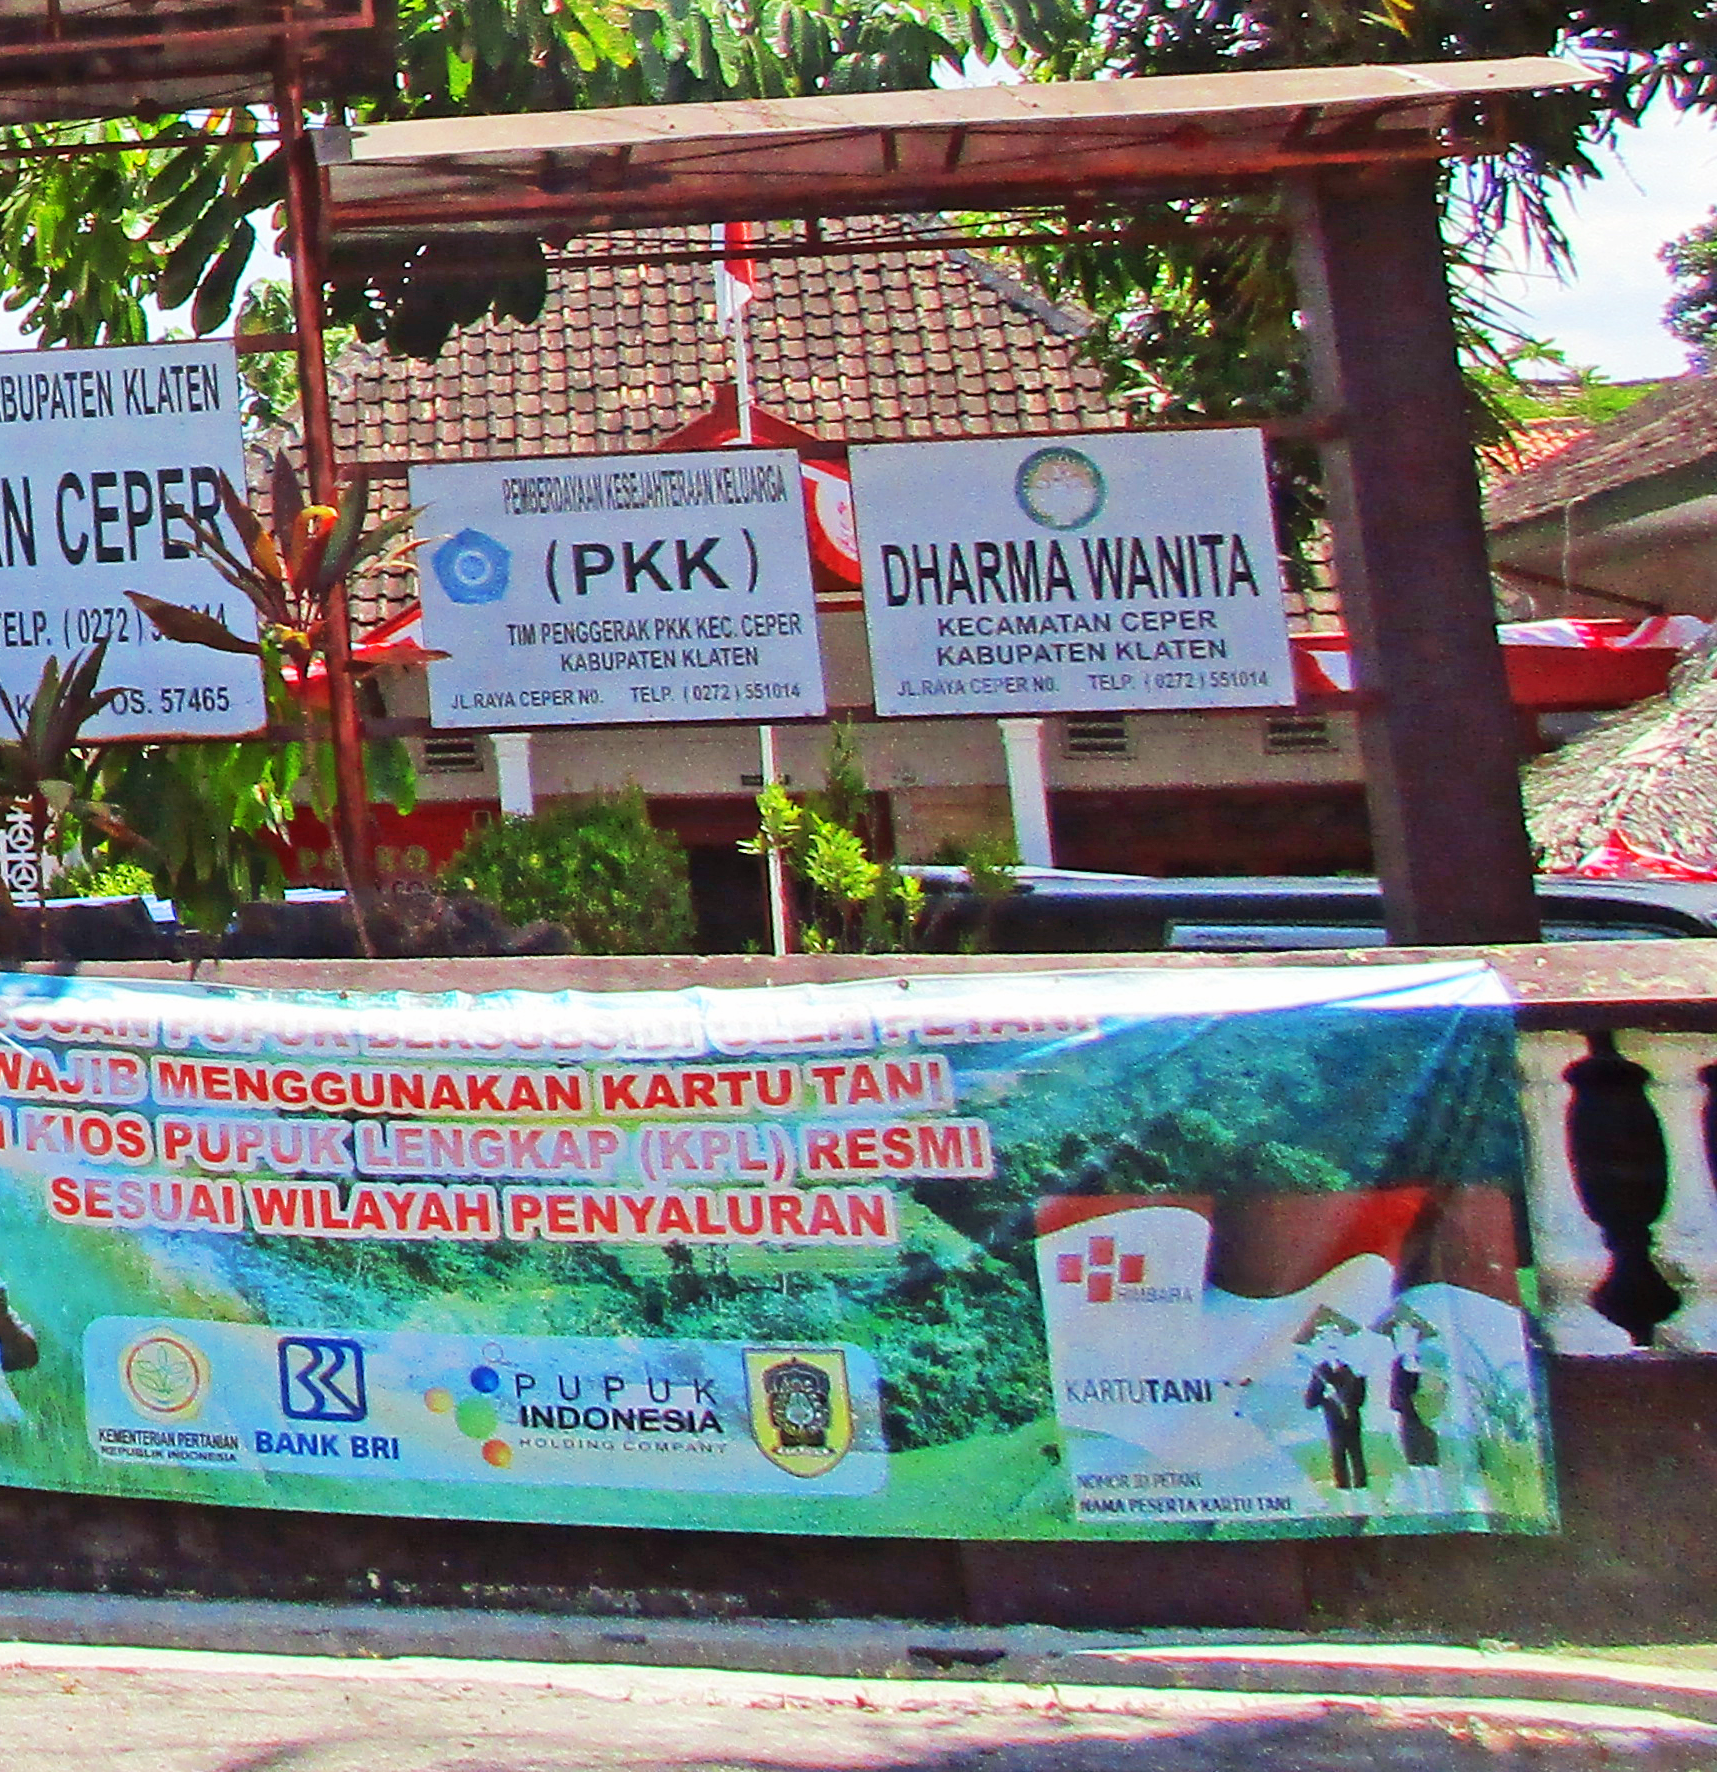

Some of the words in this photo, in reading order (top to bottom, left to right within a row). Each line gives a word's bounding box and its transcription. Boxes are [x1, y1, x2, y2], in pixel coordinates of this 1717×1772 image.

[124, 363, 221, 414] KLATEN
[55, 466, 226, 569] CEPER
[880, 539, 1076, 607] DHARMA
[1081, 533, 1261, 601] WANITA
[507, 623, 536, 646] TIM
[541, 619, 650, 646] PENGGERAK
[654, 617, 692, 641] PKK
[696, 615, 737, 639] KEC.
[740, 612, 803, 637] CEPER
[937, 612, 1113, 639] KECAMATAN
[1121, 609, 1218, 633] CEPER
[560, 648, 676, 673] KABUPATEN
[683, 646, 759, 669] KLATEN
[936, 641, 1107, 667] KABUPATEN
[1116, 638, 1227, 661] KLATEN
[519, 689, 574, 708] CEPER
[745, 682, 801, 701] 551014
[969, 674, 1028, 695] CEPER
[1209, 670, 1269, 689] 551014
[161, 686, 230, 714] 57465
[162, 1062, 583, 1112] MENGGUNAKAN
[602, 1068, 793, 1111] KARTU
[812, 1061, 941, 1106] TANI
[25, 1114, 147, 1160] KIOS
[165, 1121, 348, 1167] PUPUK
[366, 1126, 620, 1170] LENGKAP
[640, 1126, 786, 1183] (KPL)
[809, 1124, 985, 1172] RESMI
[51, 1176, 236, 1226] SESUAI
[253, 1187, 494, 1234] WILAYAH
[511, 1189, 887, 1239] PENYALURAN
[514, 1373, 718, 1406] PUPUK
[519, 1404, 725, 1435] INDONESIA
[99, 1428, 177, 1448] KEMENTERIAN
[177, 1431, 239, 1451] PERTANIAN
[255, 1430, 341, 1457] BANK
[351, 1435, 400, 1461] BRI
[518, 1437, 615, 1452] HOLDING
[623, 1439, 729, 1455] COMPANY
[166, 1449, 238, 1463] INDONESIA
